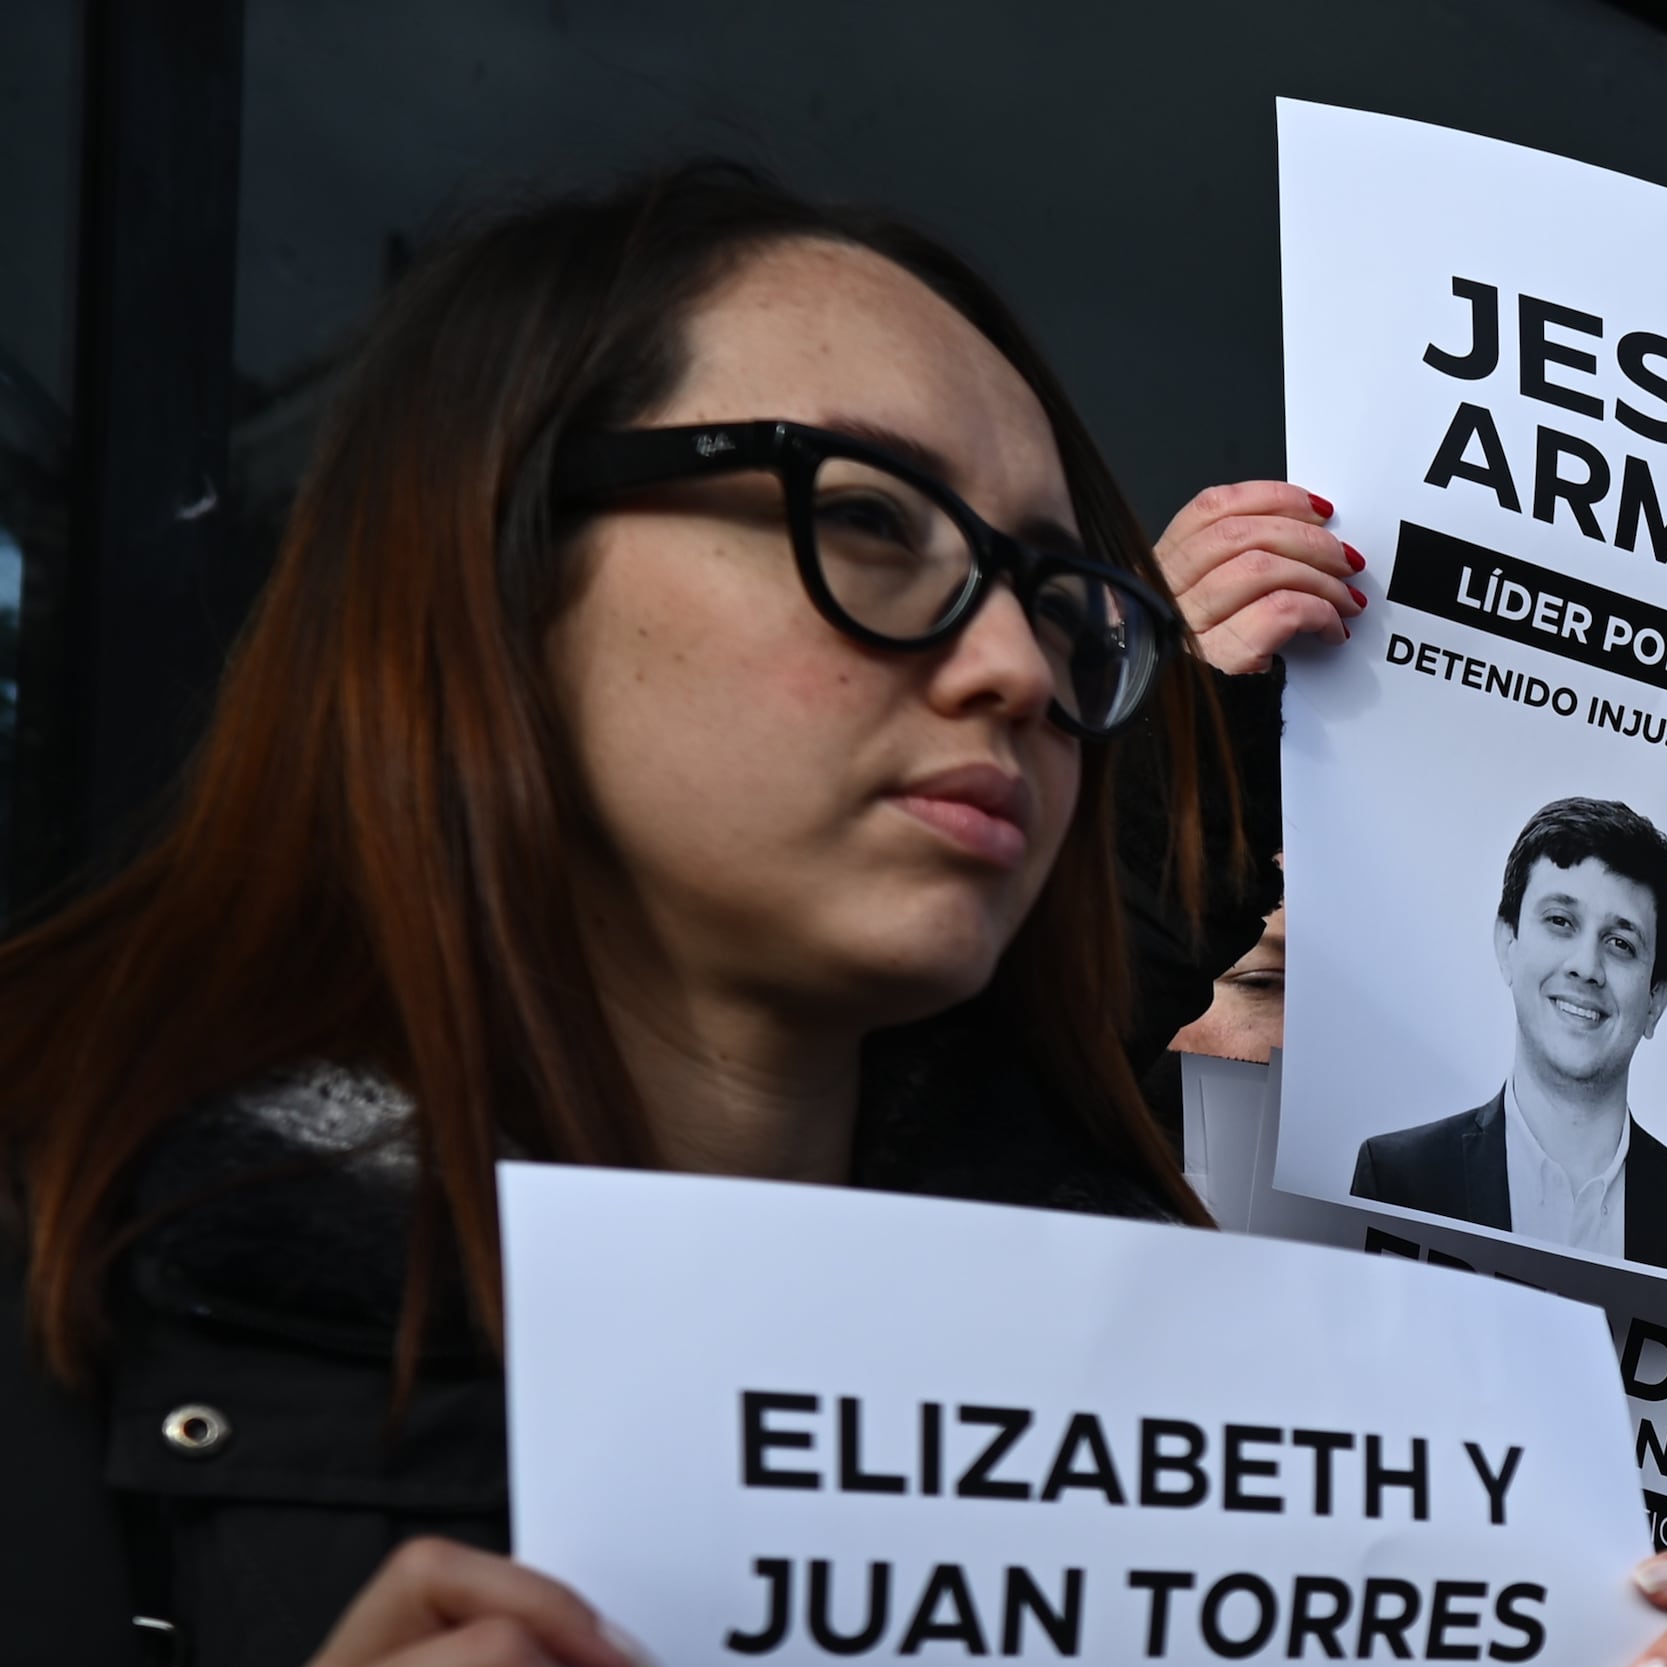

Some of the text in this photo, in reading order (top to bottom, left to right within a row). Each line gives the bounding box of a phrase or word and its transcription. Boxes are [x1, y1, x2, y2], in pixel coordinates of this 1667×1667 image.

[1456, 566, 1593, 644] LÍDER
[1385, 633, 1579, 718] DETENIDO
[741, 1390, 1430, 1522] ELIZABETH
[1462, 1442, 1524, 1526] Y
[725, 1558, 1548, 1664] JUAN TORRES
